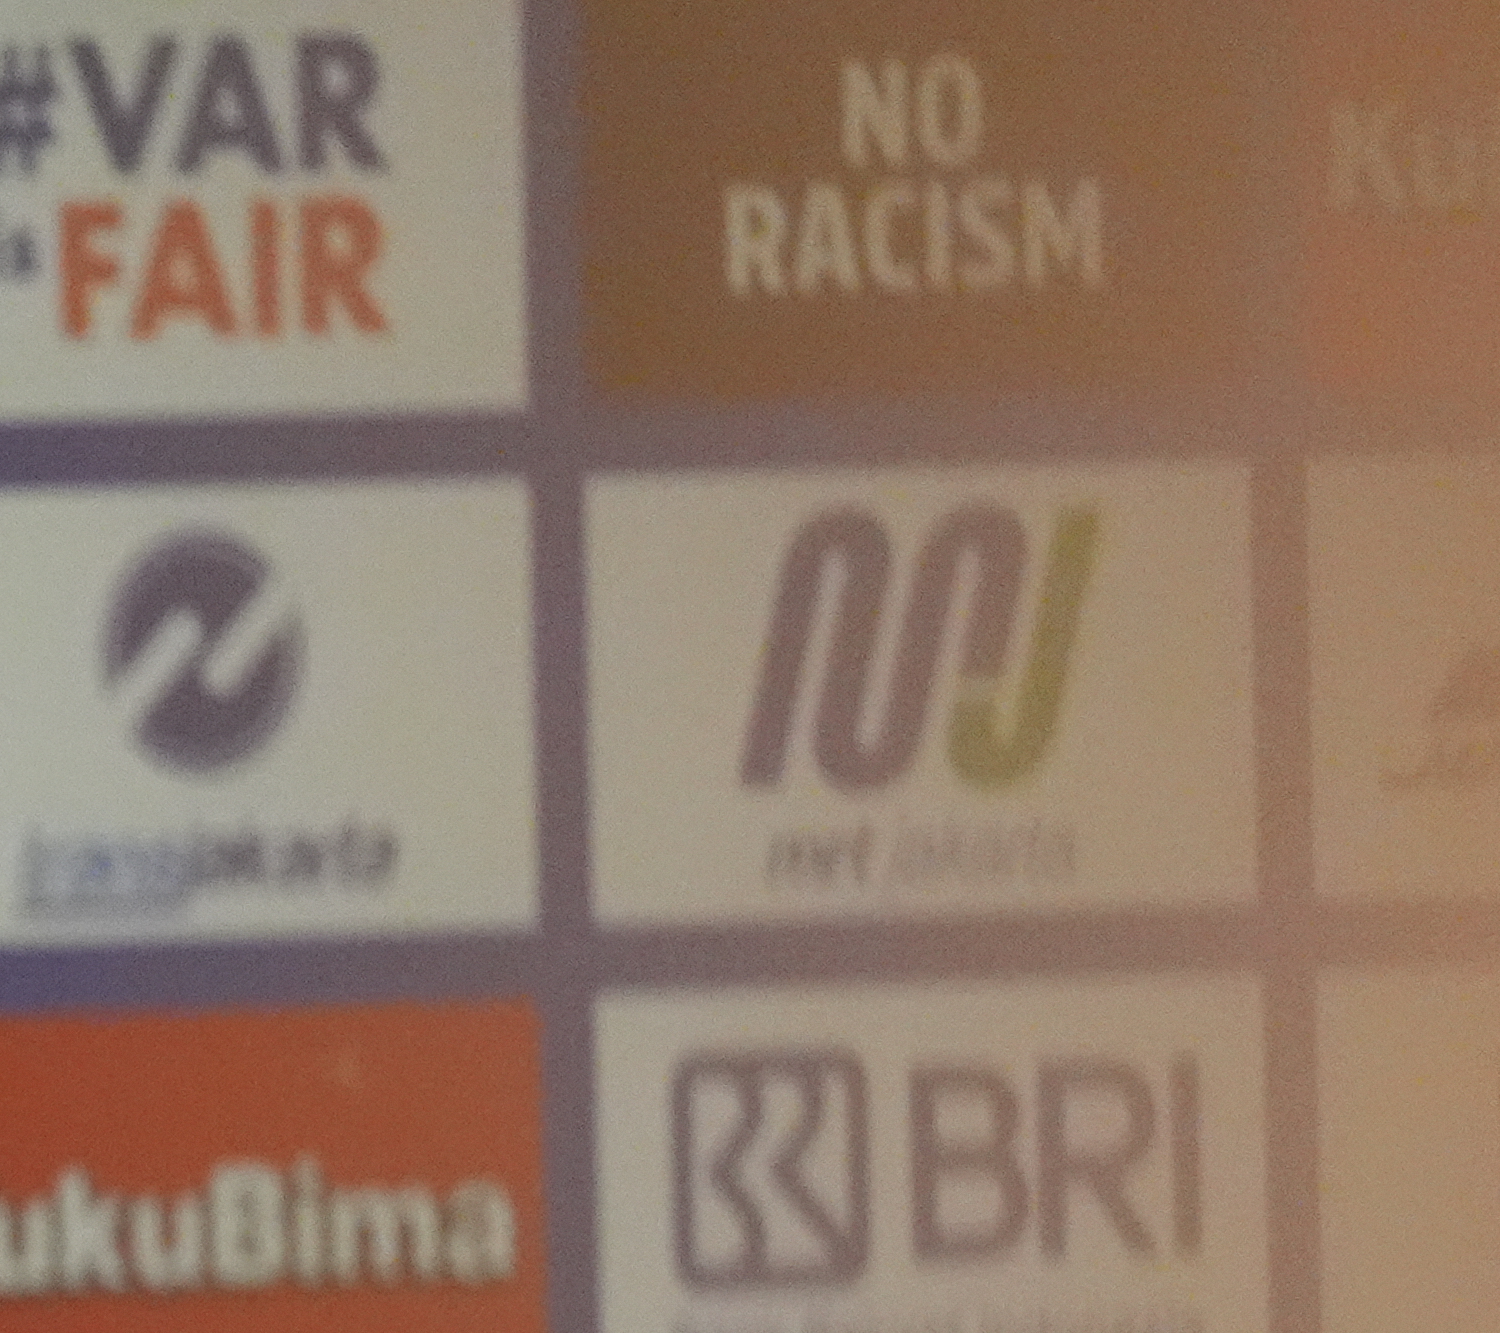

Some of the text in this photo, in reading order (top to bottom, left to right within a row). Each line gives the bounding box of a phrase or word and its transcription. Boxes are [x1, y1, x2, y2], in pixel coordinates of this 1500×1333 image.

[841, 52, 985, 168] NO
[57, 192, 388, 342] FAIR
[724, 178, 1104, 293] RACISM
[908, 1048, 1203, 1268] BRI
